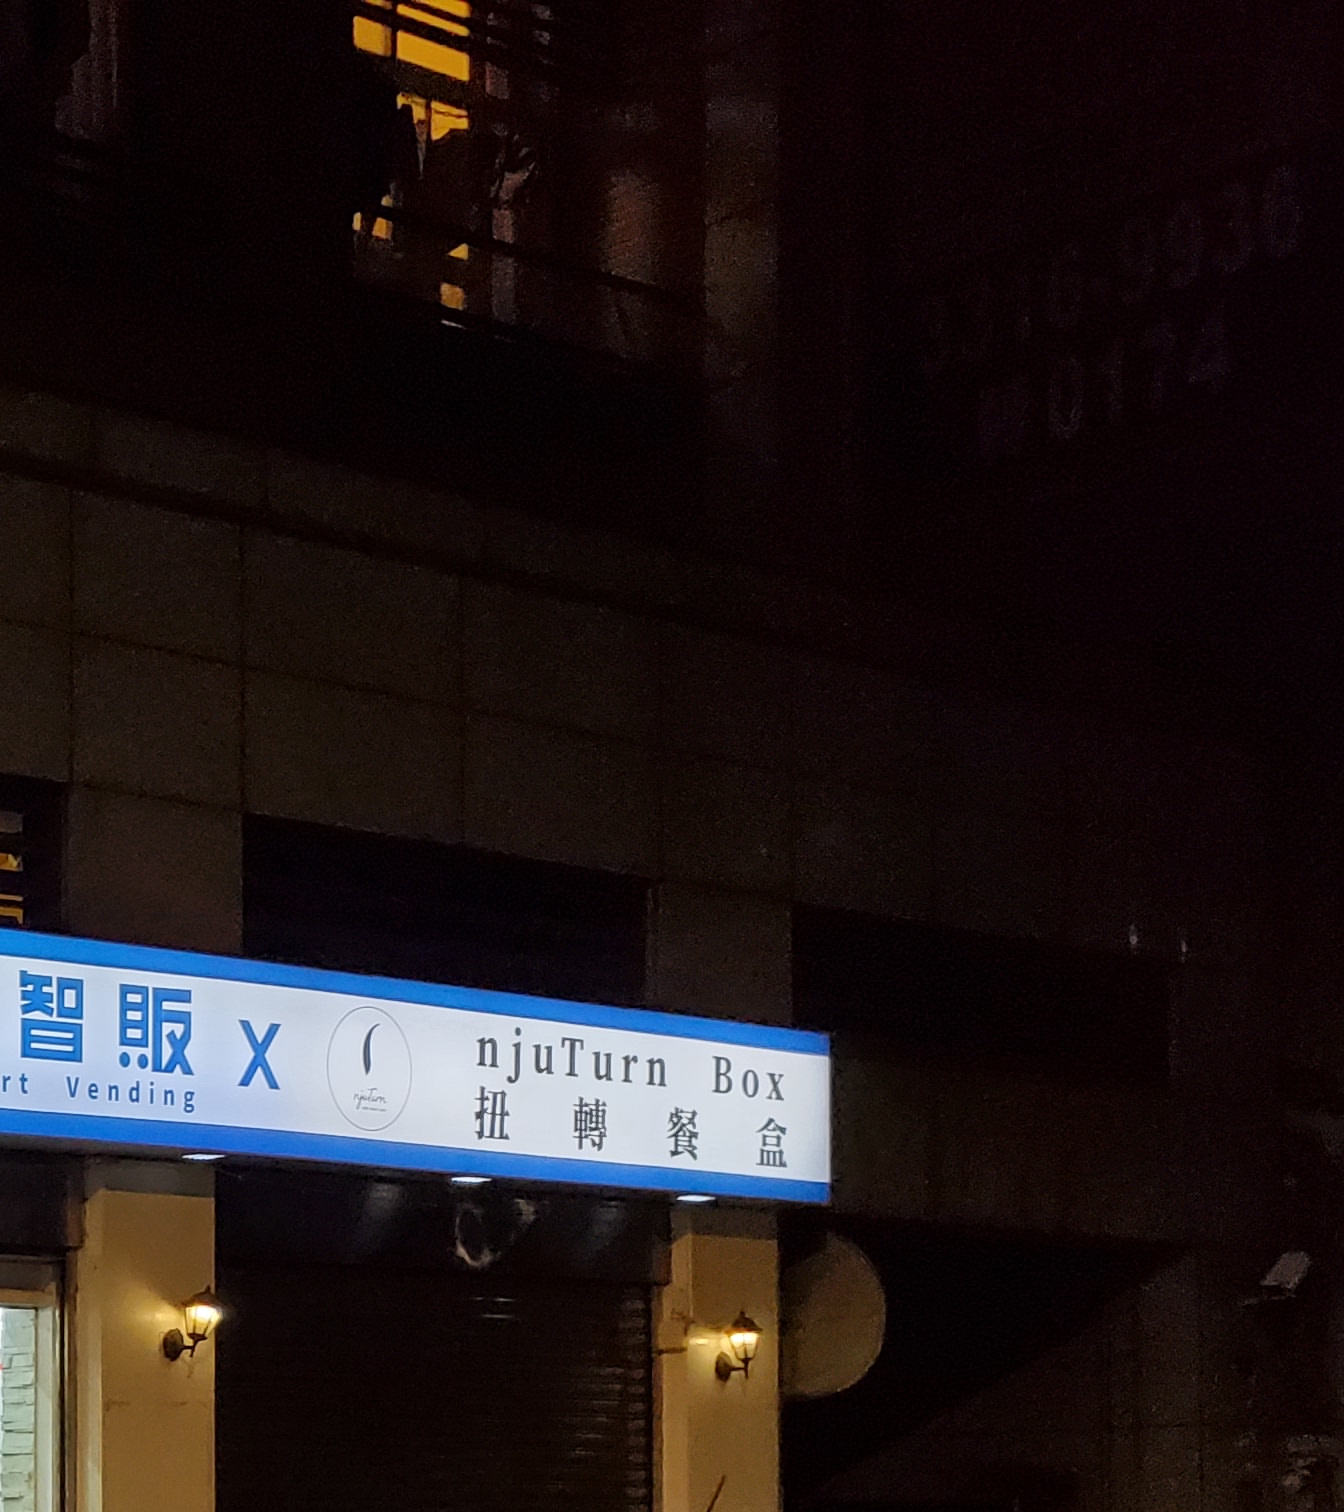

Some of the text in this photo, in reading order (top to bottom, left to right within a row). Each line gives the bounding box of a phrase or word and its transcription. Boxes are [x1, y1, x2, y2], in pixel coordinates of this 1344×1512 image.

[66, 1075, 196, 1113] Vending
[476, 1026, 786, 1101] njuTurn Box
[474, 1085, 788, 1168] 扭轉餐盒
